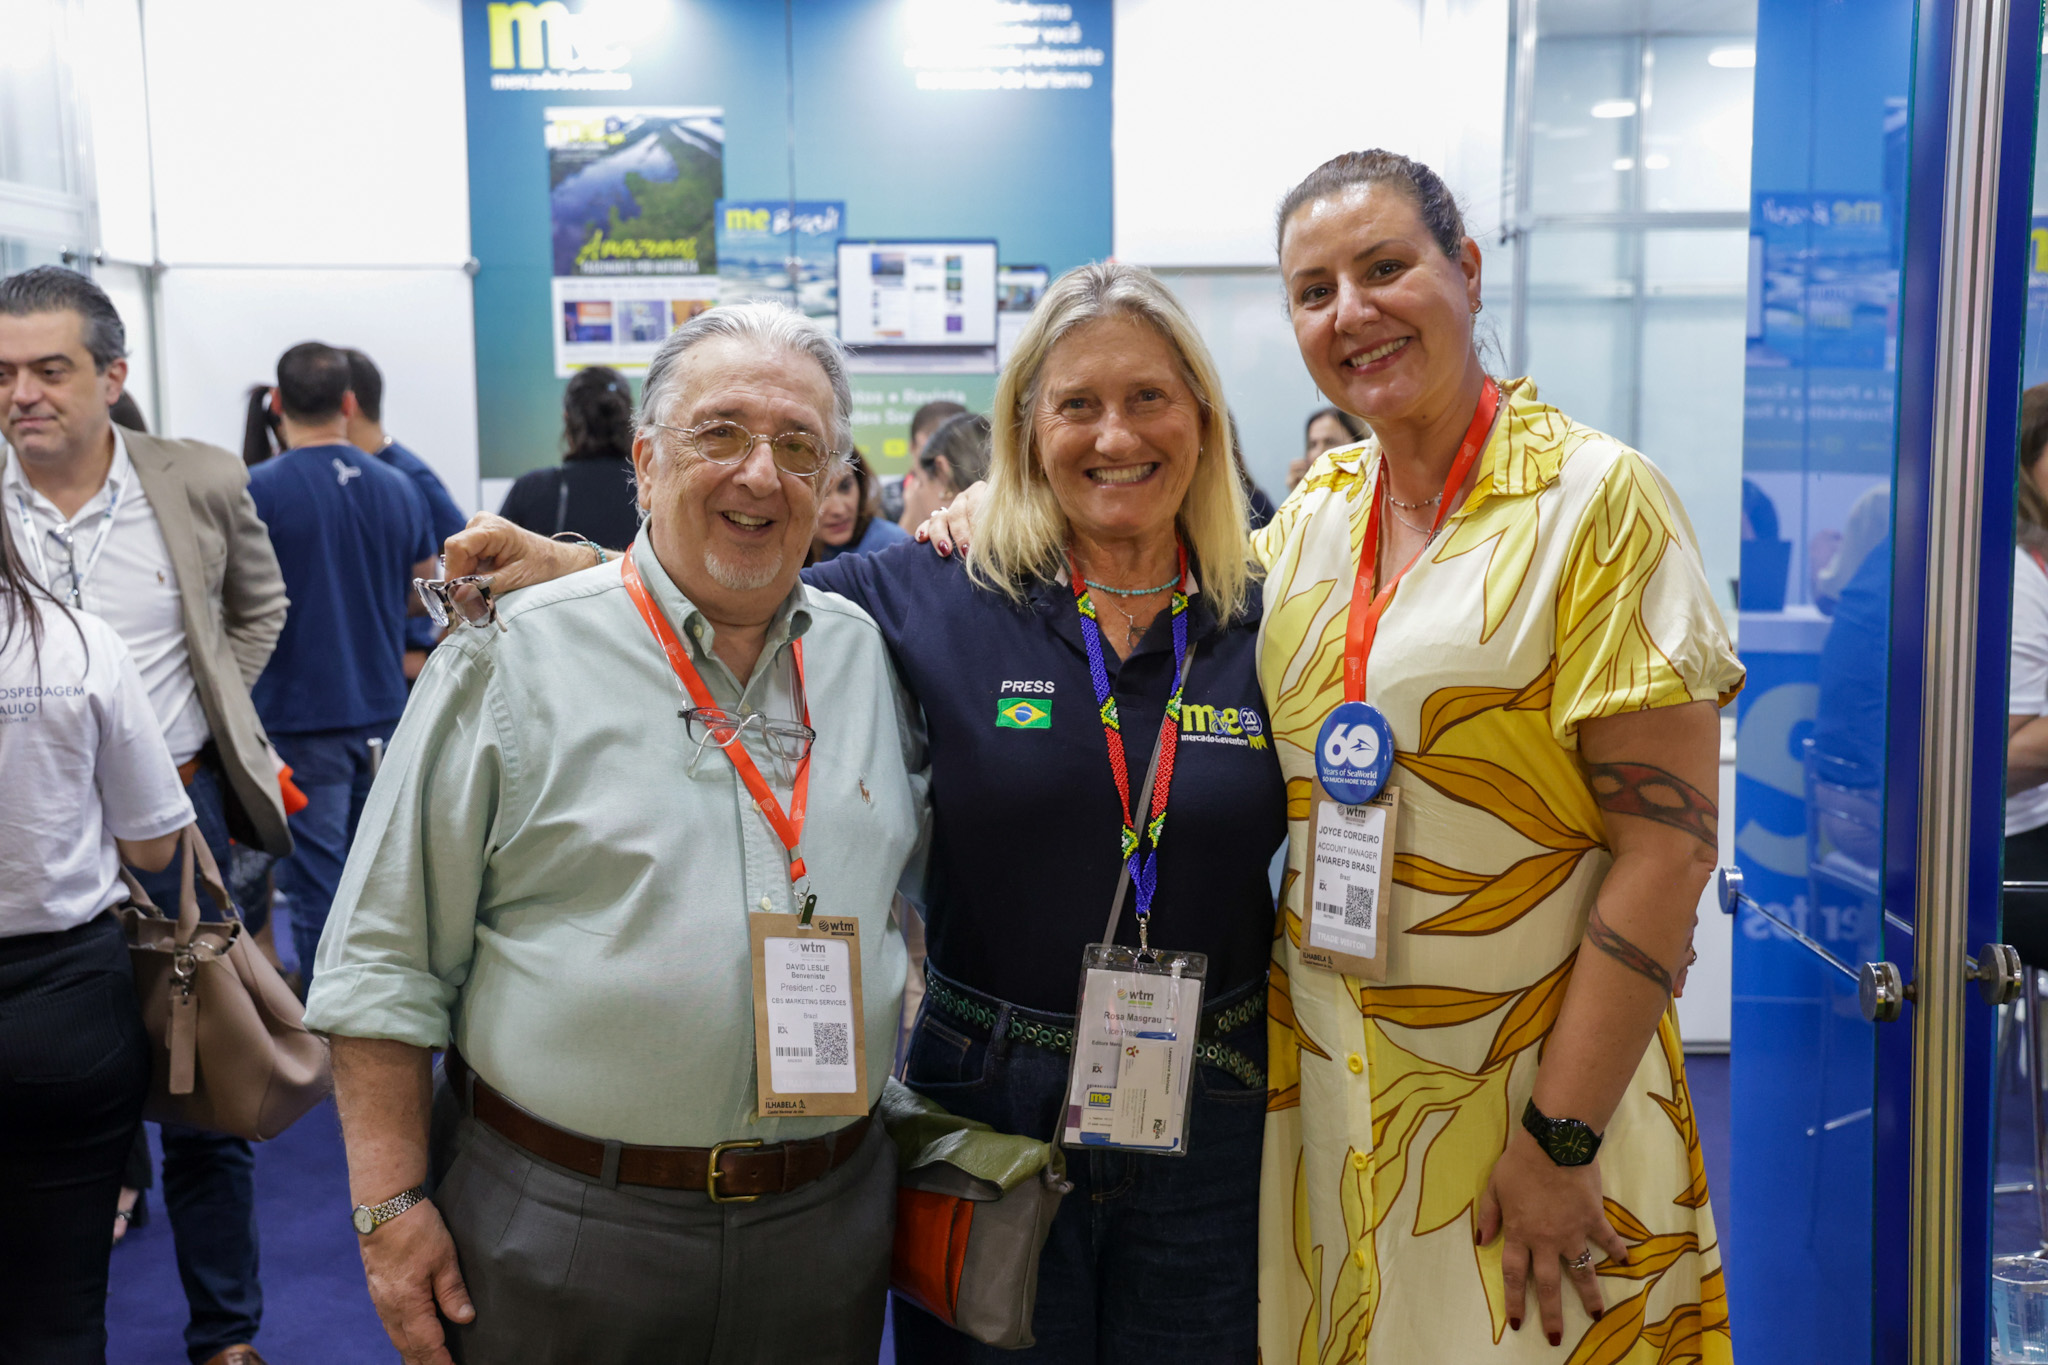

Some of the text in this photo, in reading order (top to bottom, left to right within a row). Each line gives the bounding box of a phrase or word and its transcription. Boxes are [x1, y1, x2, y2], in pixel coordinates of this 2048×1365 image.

[1001, 680, 1055, 693] PRESS
[1242, 711, 1257, 724] 20
[1181, 734, 1248, 746] mercado&eventos
[1322, 767, 1378, 779] Years of SeaWorld
[1346, 805, 1366, 818] wtm
[1319, 826, 1379, 844] JOYCE CORDEIRO
[1318, 842, 1377, 860] ACCOUNT MANAGER
[1317, 854, 1376, 874] AVIAREPS BRASIL
[830, 921, 854, 931] wtm
[1317, 931, 1366, 950] TRADE VISITOR
[800, 942, 826, 953] wtm
[786, 963, 830, 972] DAVID LESLIE
[791, 972, 826, 980] Benveniste
[780, 983, 814, 993] President
[820, 985, 837, 993] CEO
[1129, 989, 1155, 1001] wtm
[785, 998, 818, 1006] MARKETING
[1104, 1011, 1162, 1024] Rosa Masgrau
[765, 1101, 797, 1109] ILHABELA
